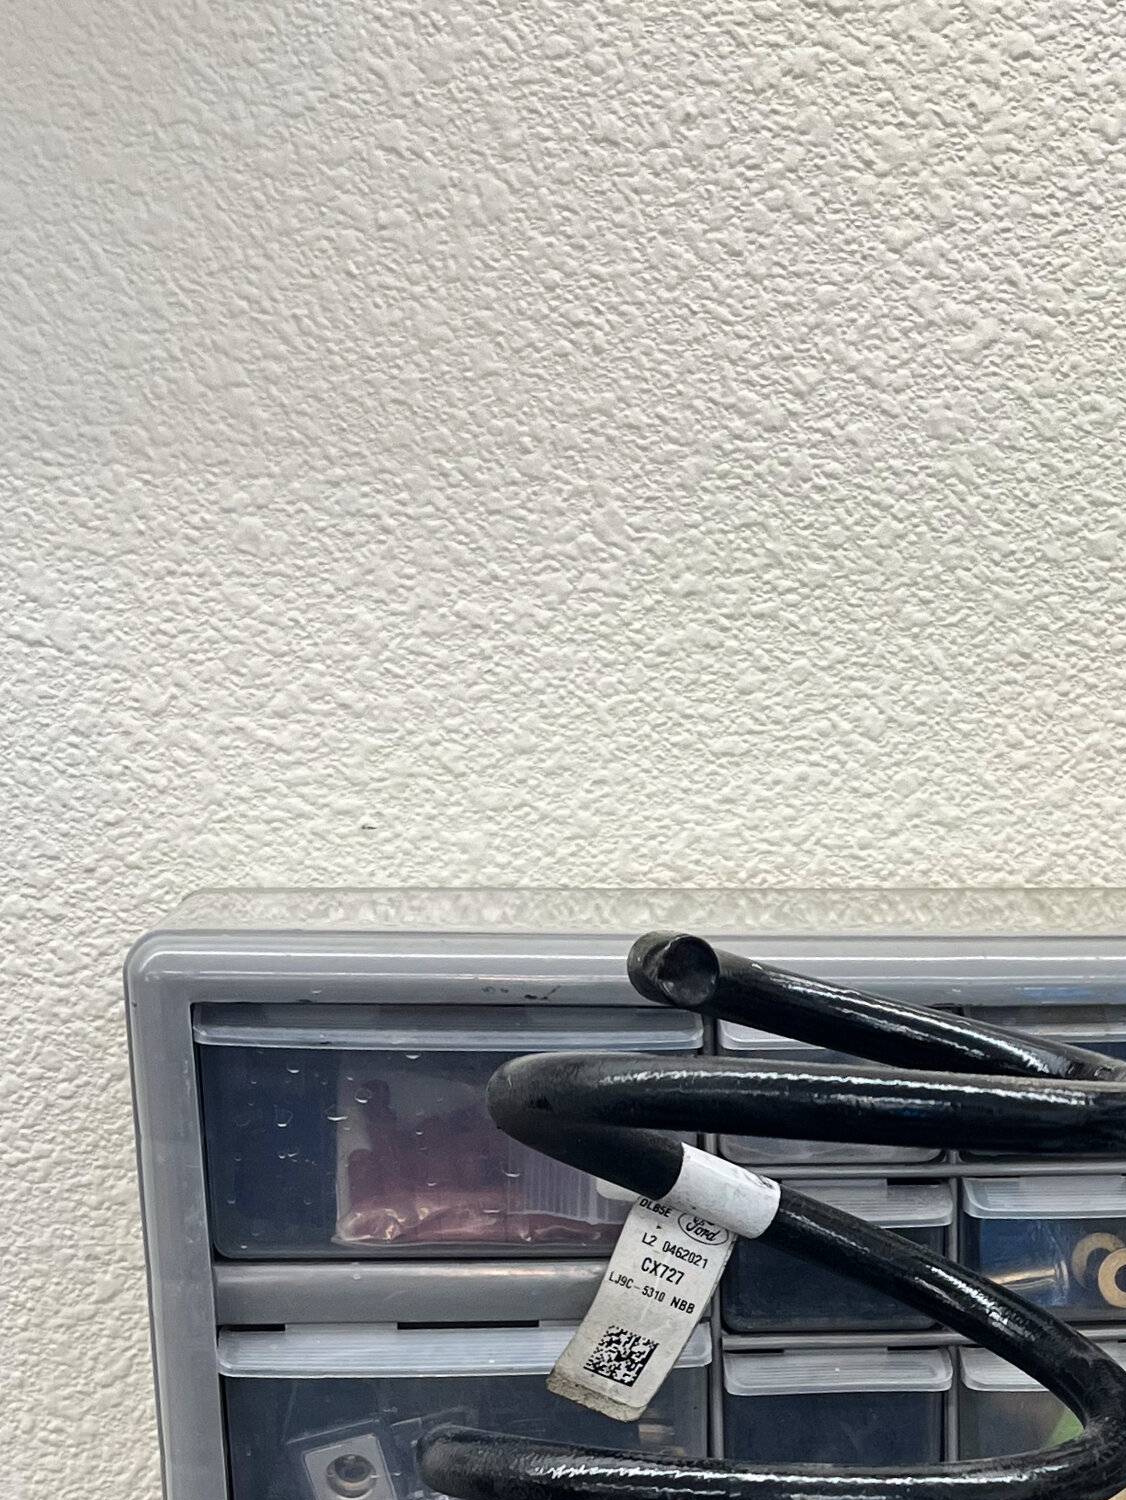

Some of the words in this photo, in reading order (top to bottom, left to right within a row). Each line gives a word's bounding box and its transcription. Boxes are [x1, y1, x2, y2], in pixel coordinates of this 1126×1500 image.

[686, 1216, 721, 1241] Ford
[641, 1232, 657, 1247] L2
[662, 1240, 708, 1269] 0462021
[641, 1257, 685, 1285] CX727
[670, 1296, 695, 1314] NBB
